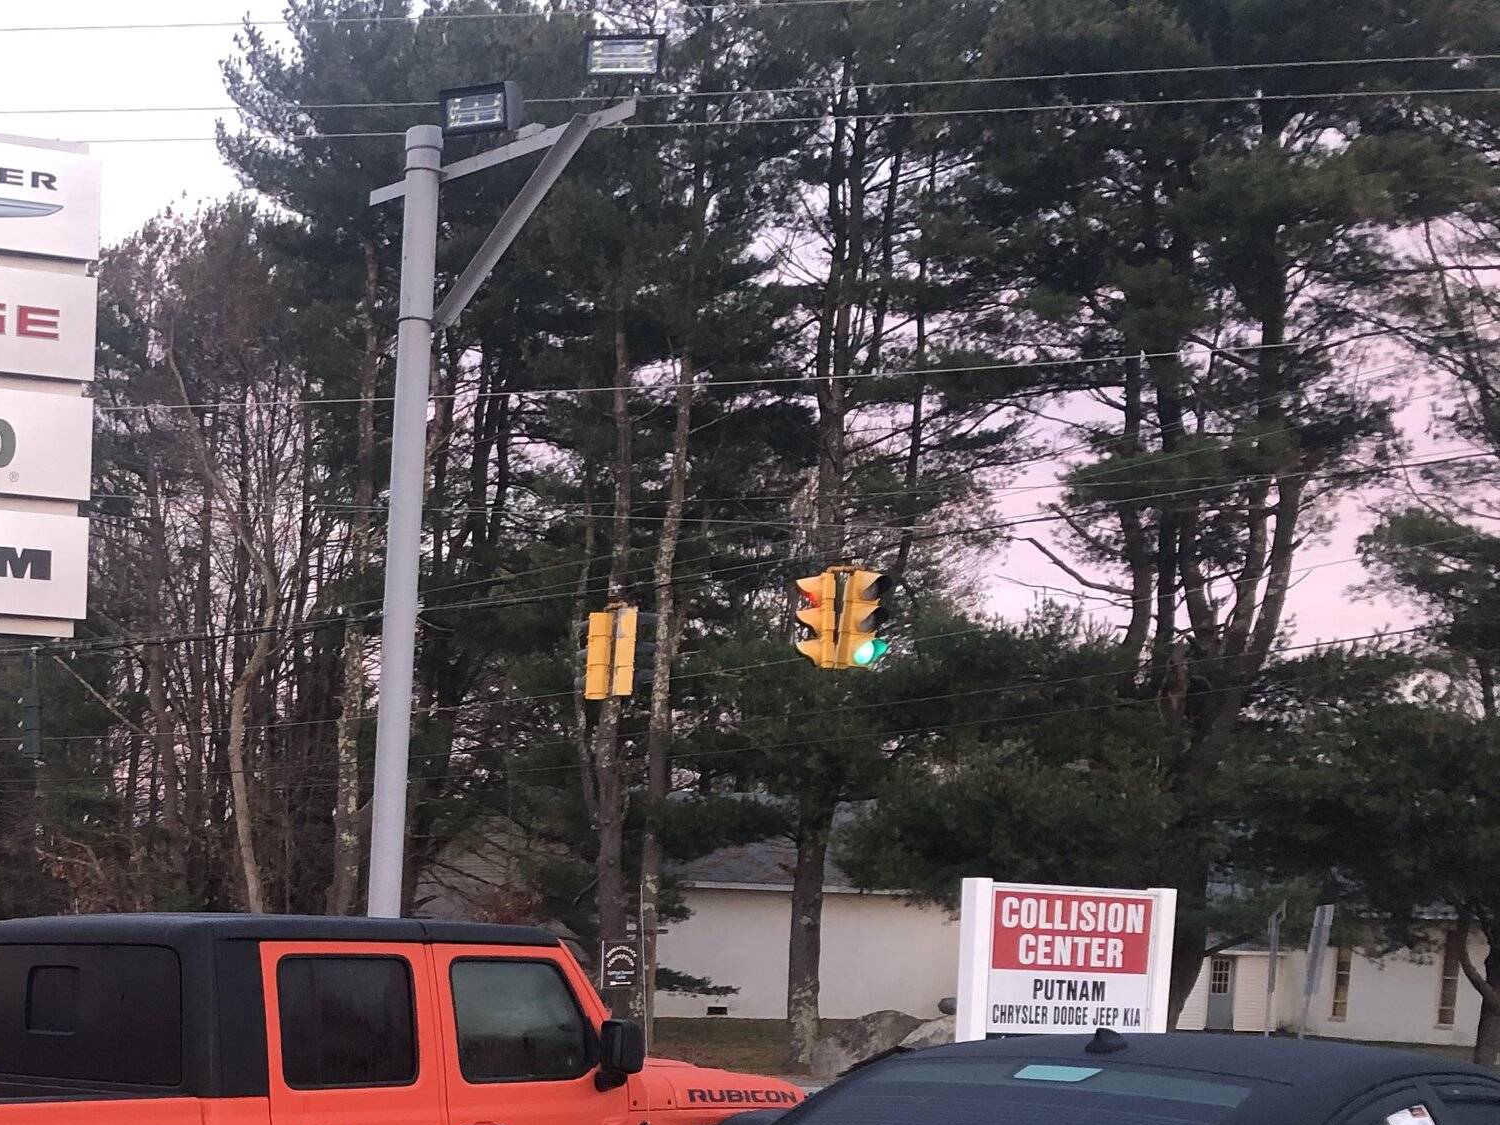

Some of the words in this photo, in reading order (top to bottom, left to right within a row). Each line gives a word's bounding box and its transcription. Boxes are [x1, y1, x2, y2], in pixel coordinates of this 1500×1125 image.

[1001, 896, 1145, 934] COLLISION
[1018, 933, 1125, 968] CENTER
[1032, 978, 1106, 1002] PUTNAM
[992, 1003, 1048, 1025] CHRYSLER
[1053, 1006, 1088, 1026] DODGE
[1092, 1007, 1119, 1026] JEEP
[1123, 1007, 1141, 1027] KIA
[688, 1088, 797, 1104] RUBICON
